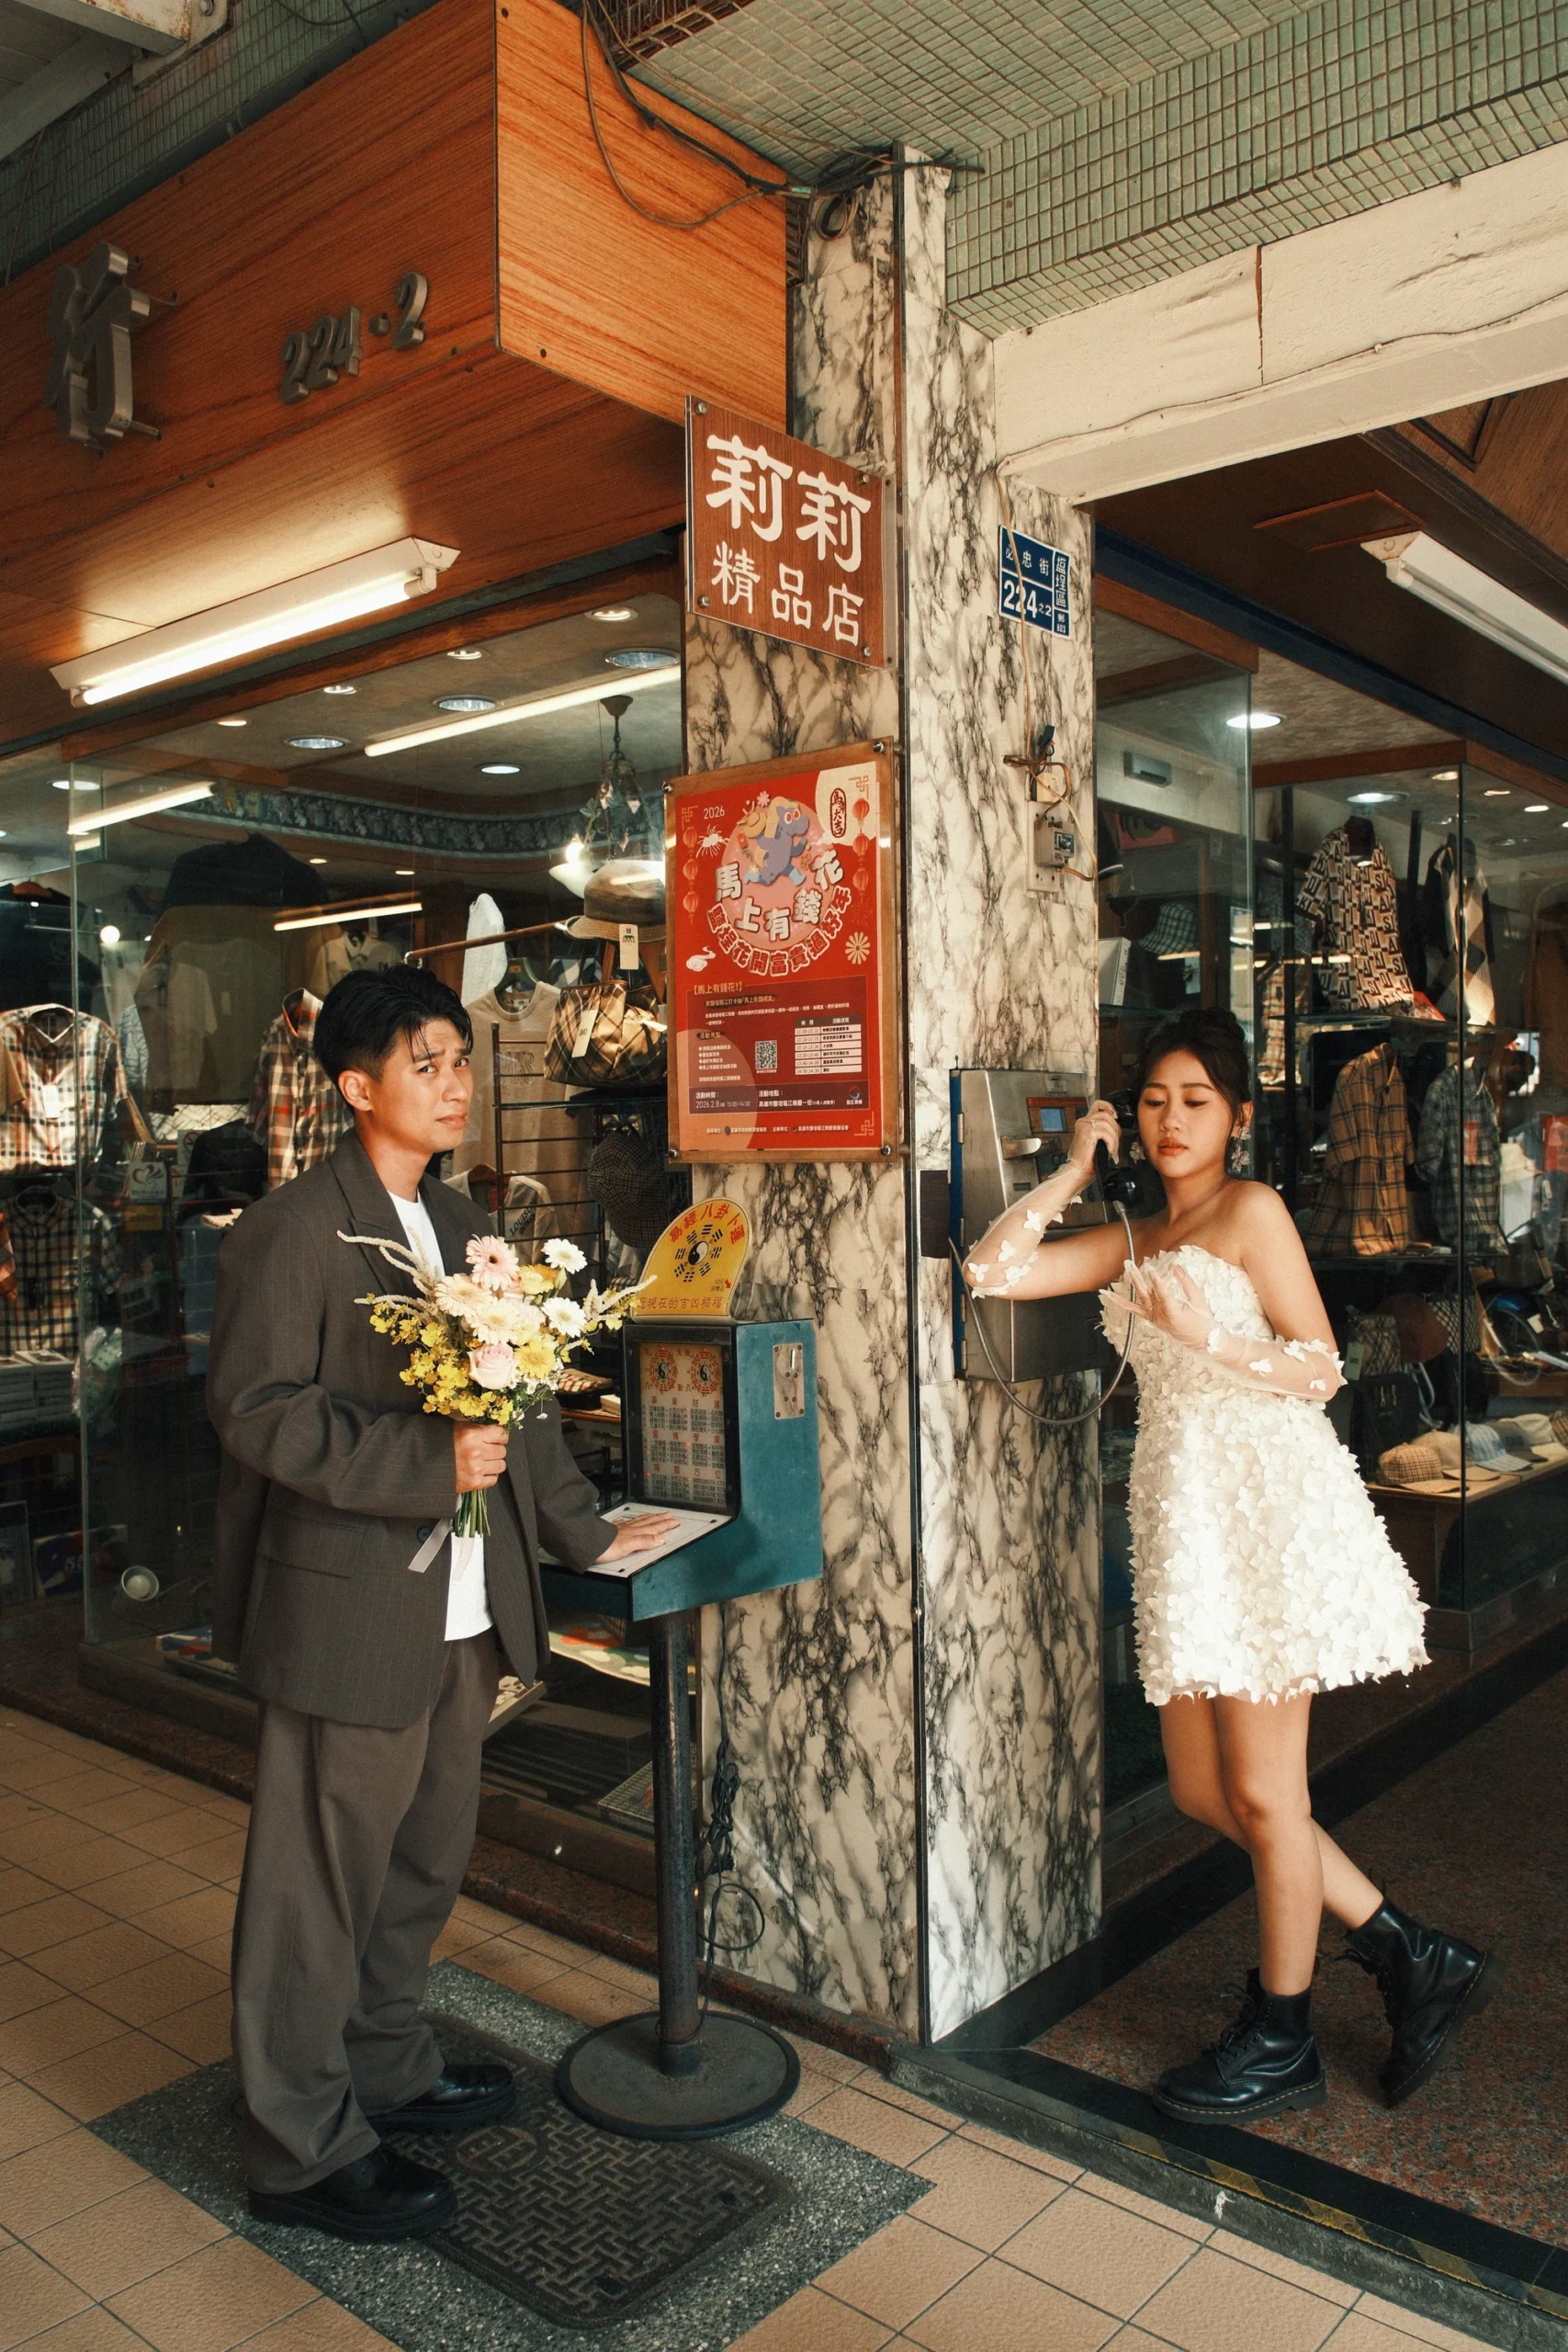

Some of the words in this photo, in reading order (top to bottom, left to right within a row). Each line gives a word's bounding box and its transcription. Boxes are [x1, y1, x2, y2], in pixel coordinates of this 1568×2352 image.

[705, 435, 872, 572] 莉莉
[711, 541, 864, 646] 精品店
[703, 805, 726, 820] 2026
